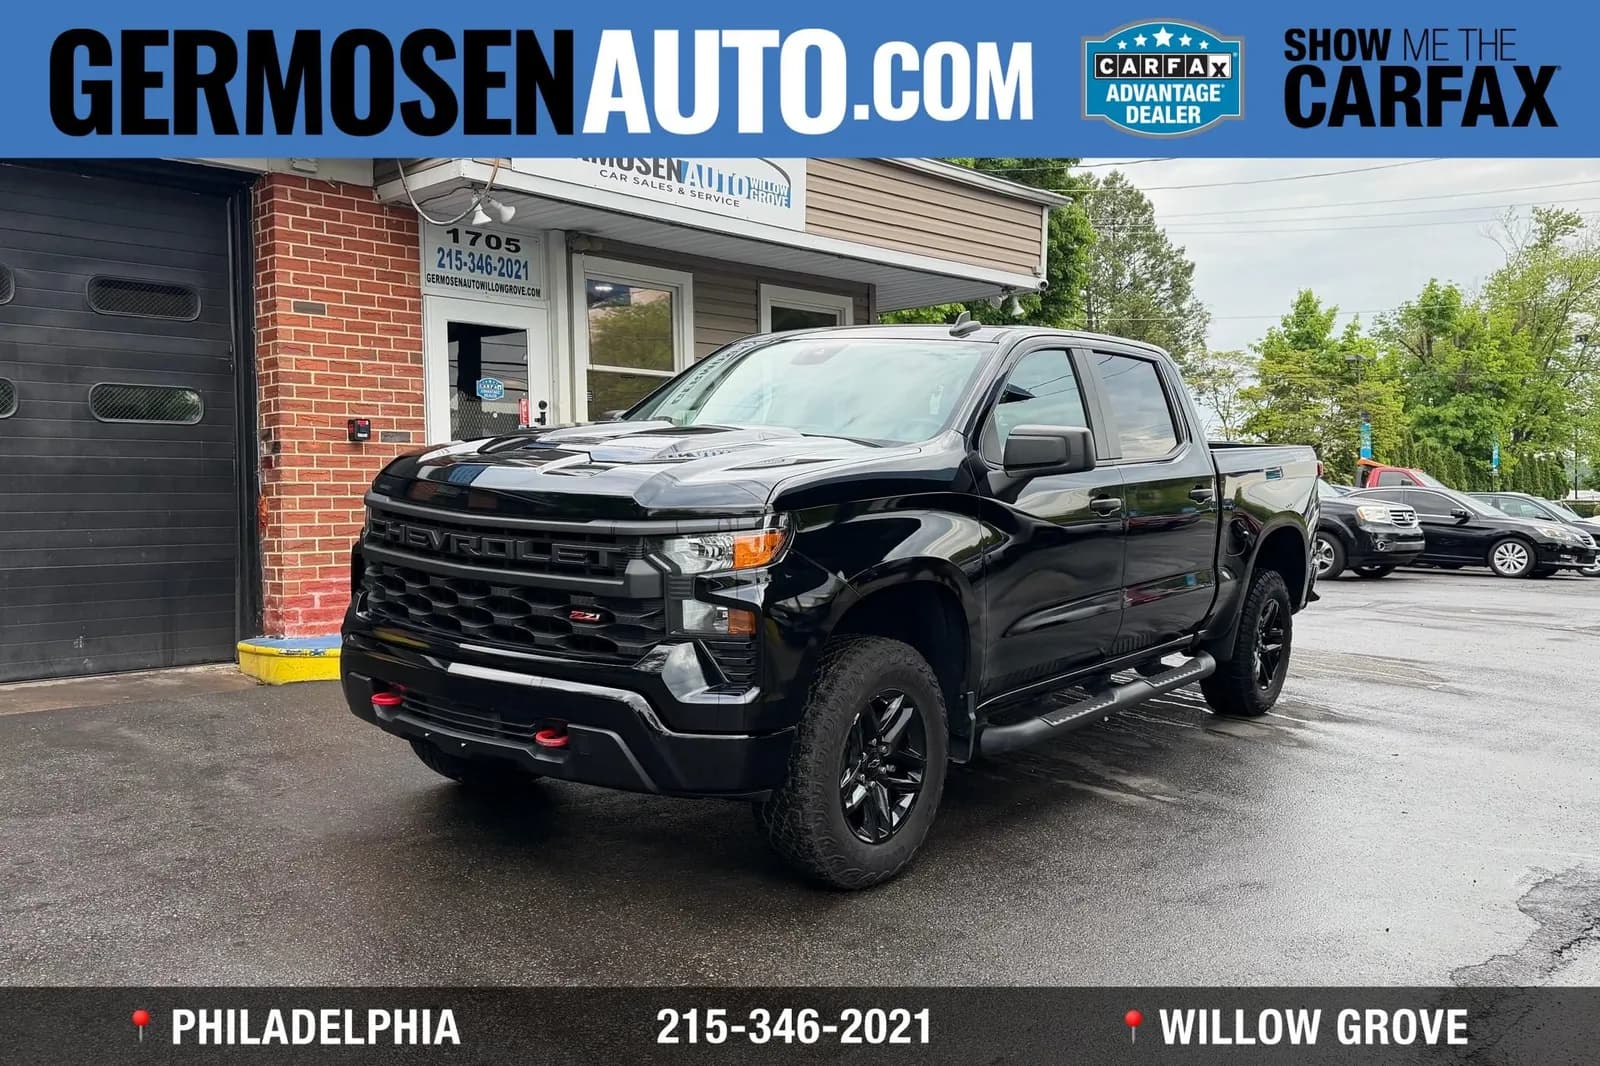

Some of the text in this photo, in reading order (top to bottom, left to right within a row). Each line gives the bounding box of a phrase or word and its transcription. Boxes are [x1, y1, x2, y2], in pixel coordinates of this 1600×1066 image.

[599, 168, 741, 208] CAR SALES & SERVICE
[750, 187, 790, 208] GROVE
[751, 176, 789, 197] WILLOW
[446, 227, 522, 254] 1705
[437, 246, 529, 281] 215-346-2021
[426, 273, 542, 298] GERMOSENAUTOWILLOWGROVE.COM
[370, 519, 627, 569] CHEVROLET
